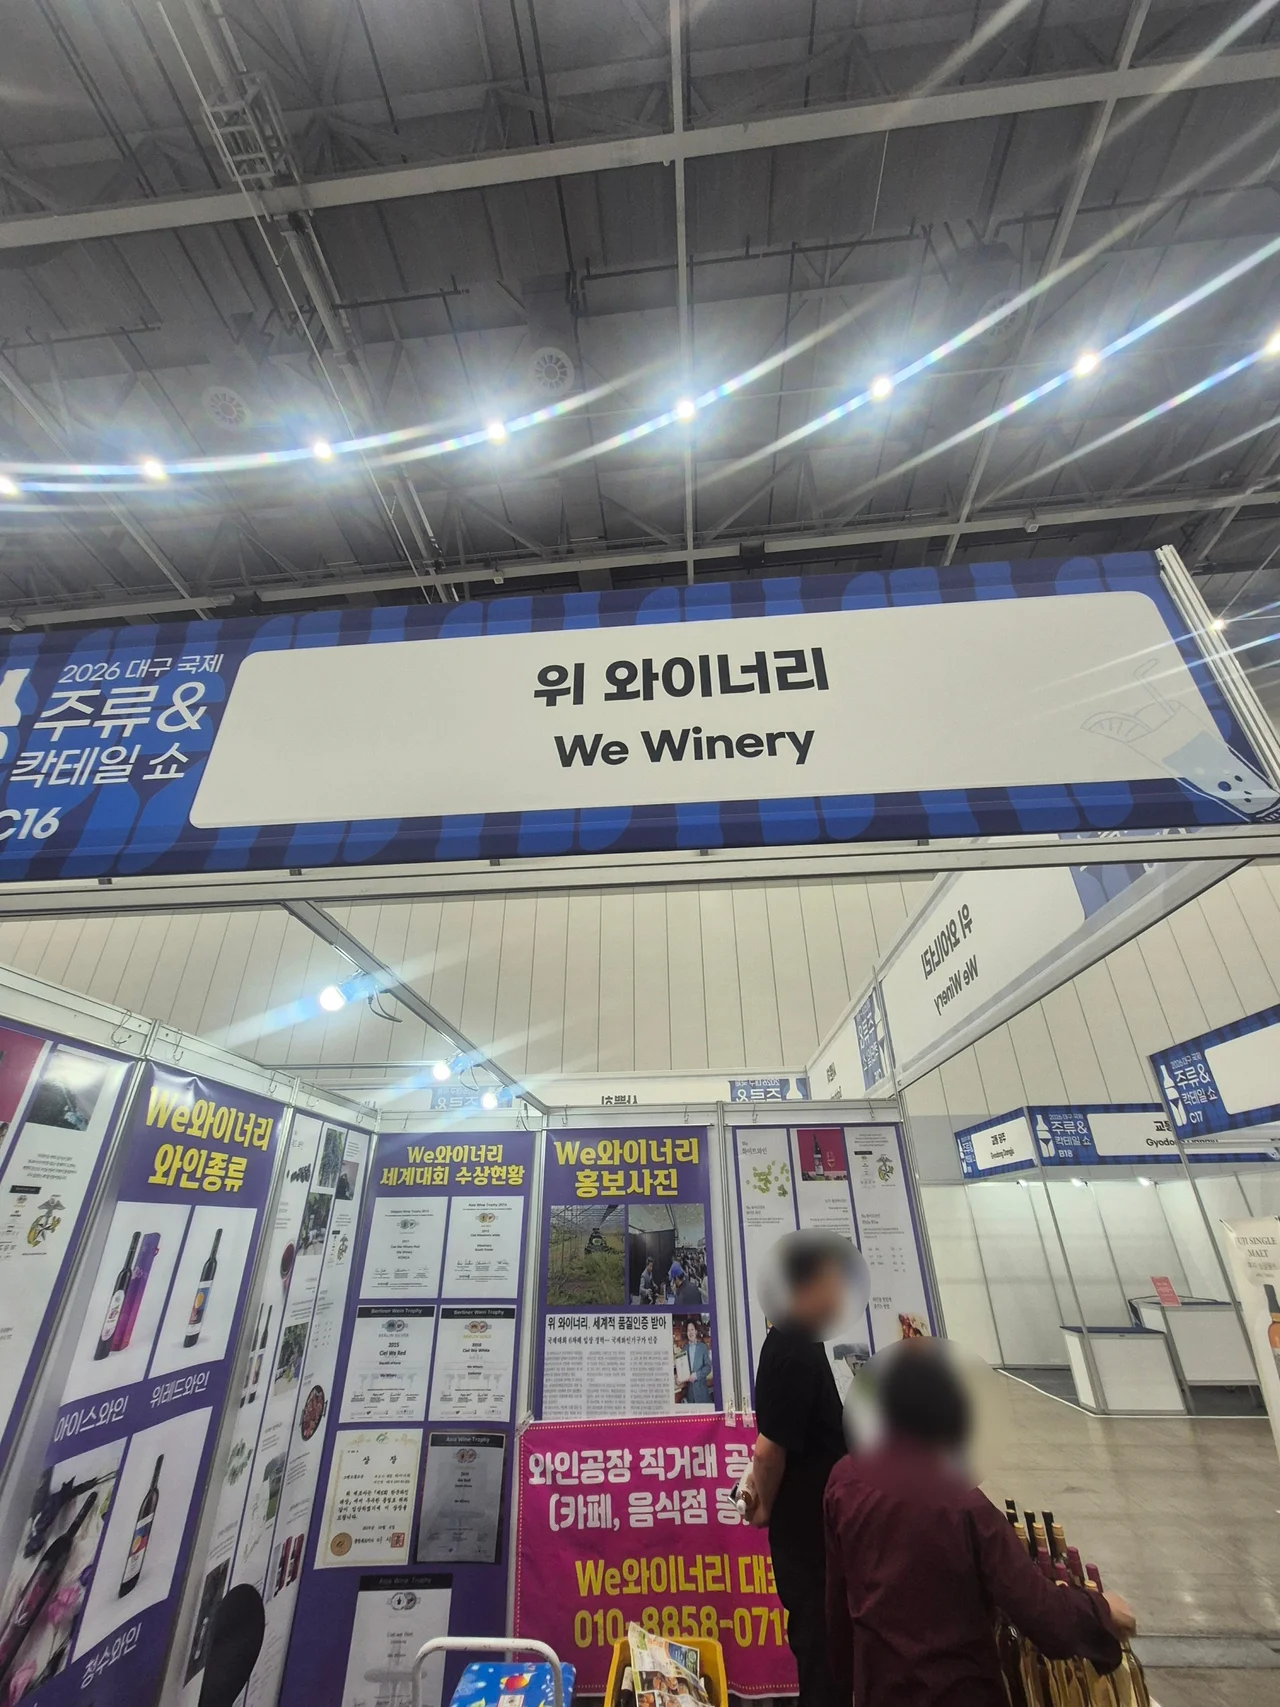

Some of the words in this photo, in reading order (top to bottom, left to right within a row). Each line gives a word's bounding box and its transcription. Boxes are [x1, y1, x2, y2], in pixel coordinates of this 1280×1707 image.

[58, 662, 121, 684] 2026
[125, 658, 173, 679] 대구
[177, 653, 224, 675] 국제
[533, 662, 585, 707] 위
[604, 647, 829, 702] 와이너리
[33, 681, 208, 742] 주류&
[554, 733, 629, 768] We
[640, 726, 815, 765] Winery
[10, 744, 141, 788] 칵테일
[142, 742, 189, 780] 쇼
[0, 807, 62, 841] C16
[1174, 1063, 1211, 1090] 주류&
[1181, 1089, 1208, 1106] 칵테일
[1207, 1086, 1218, 1100] 쇼
[145, 1086, 274, 1151] We와이너리
[1052, 1120, 1088, 1135] 주류&
[1189, 1111, 1203, 1123] C17
[407, 1144, 503, 1165] We와이너리
[553, 1137, 699, 1168] We와이너리
[1055, 1136, 1081, 1146] 칵테일
[1082, 1136, 1091, 1146] 쇼
[1058, 1149, 1073, 1158] B18
[148, 1143, 247, 1193] 와인종류
[379, 1166, 449, 1186] 세계대회
[455, 1165, 525, 1187] 수상현황
[574, 1168, 679, 1199] 홍보사진
[1247, 1249, 1269, 1258] MALT
[1249, 1236, 1278, 1246] SINGLE
[547, 1316, 555, 1330] 위
[592, 1316, 615, 1330] 세계적
[618, 1316, 649, 1330] 품질인증
[651, 1315, 667, 1330] 받아
[150, 1371, 211, 1409] 위레드와인
[54, 1395, 129, 1442] 아이스와인
[472, 1436, 490, 1444] Trophy
[528, 1448, 632, 1485] 와인공장
[639, 1444, 718, 1481] 직거래
[725, 1443, 757, 1480] 공
[549, 1493, 621, 1532] (카페,
[628, 1488, 708, 1528] 음식점
[575, 1554, 732, 1597] We와이너리
